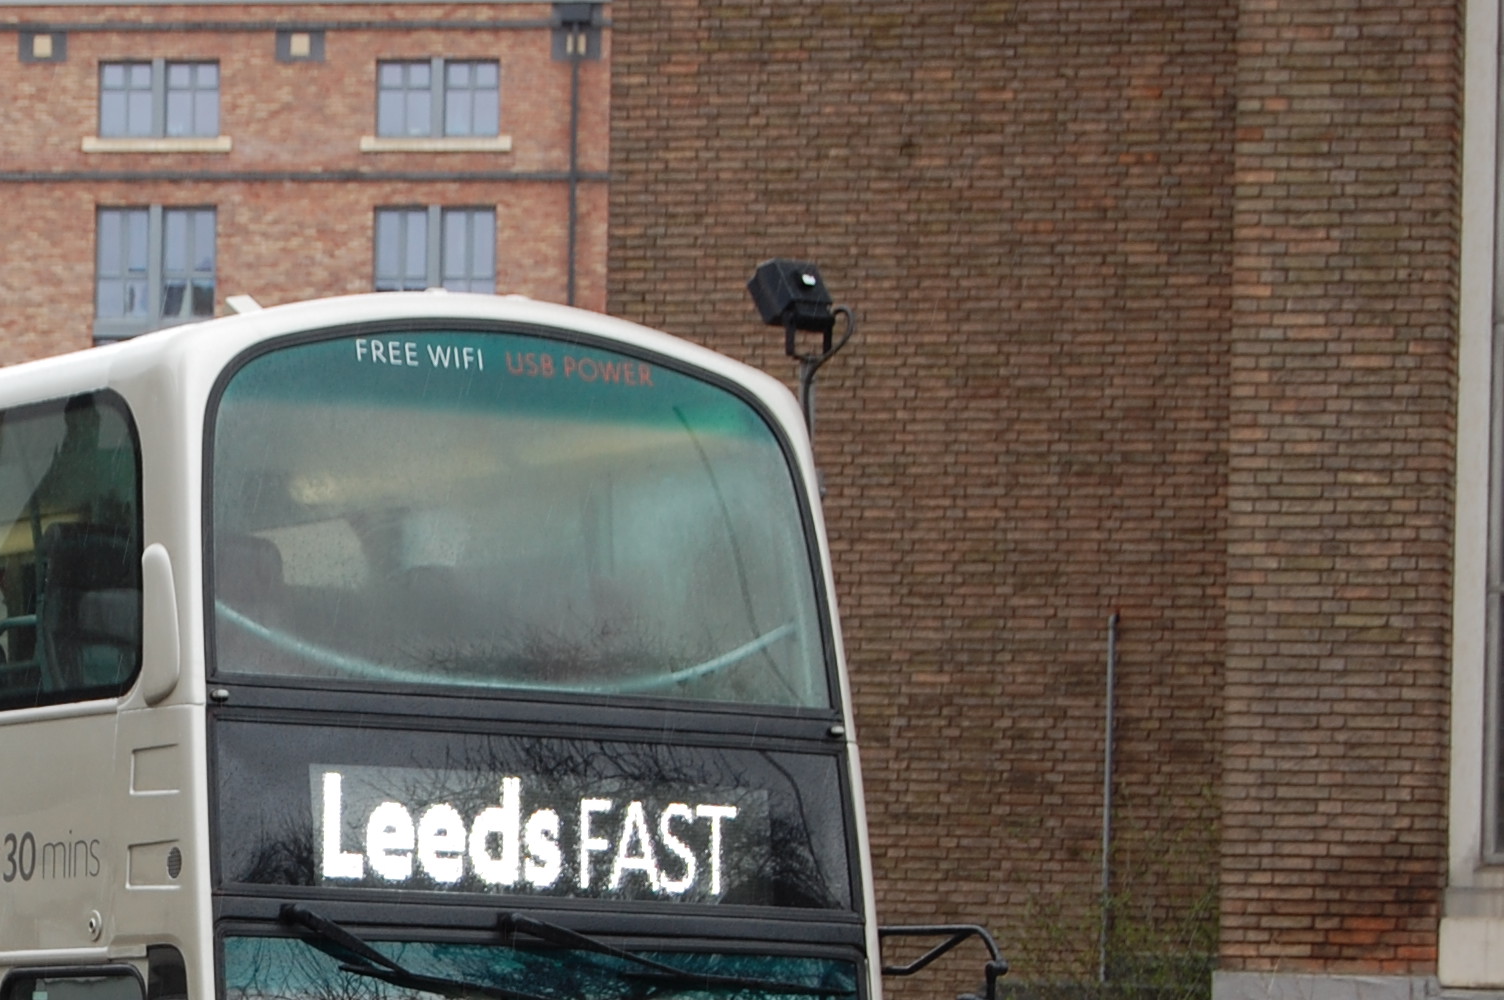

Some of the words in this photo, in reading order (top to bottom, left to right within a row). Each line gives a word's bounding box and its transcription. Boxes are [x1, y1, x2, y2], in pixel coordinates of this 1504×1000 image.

[355, 337, 419, 367] FREE
[426, 343, 484, 371] WIFI
[504, 351, 556, 378] USB
[563, 356, 655, 387] POWER
[2, 831, 37, 883] 30
[42, 828, 101, 879] mins
[322, 771, 561, 888] Leeds
[578, 797, 740, 896] FAST
